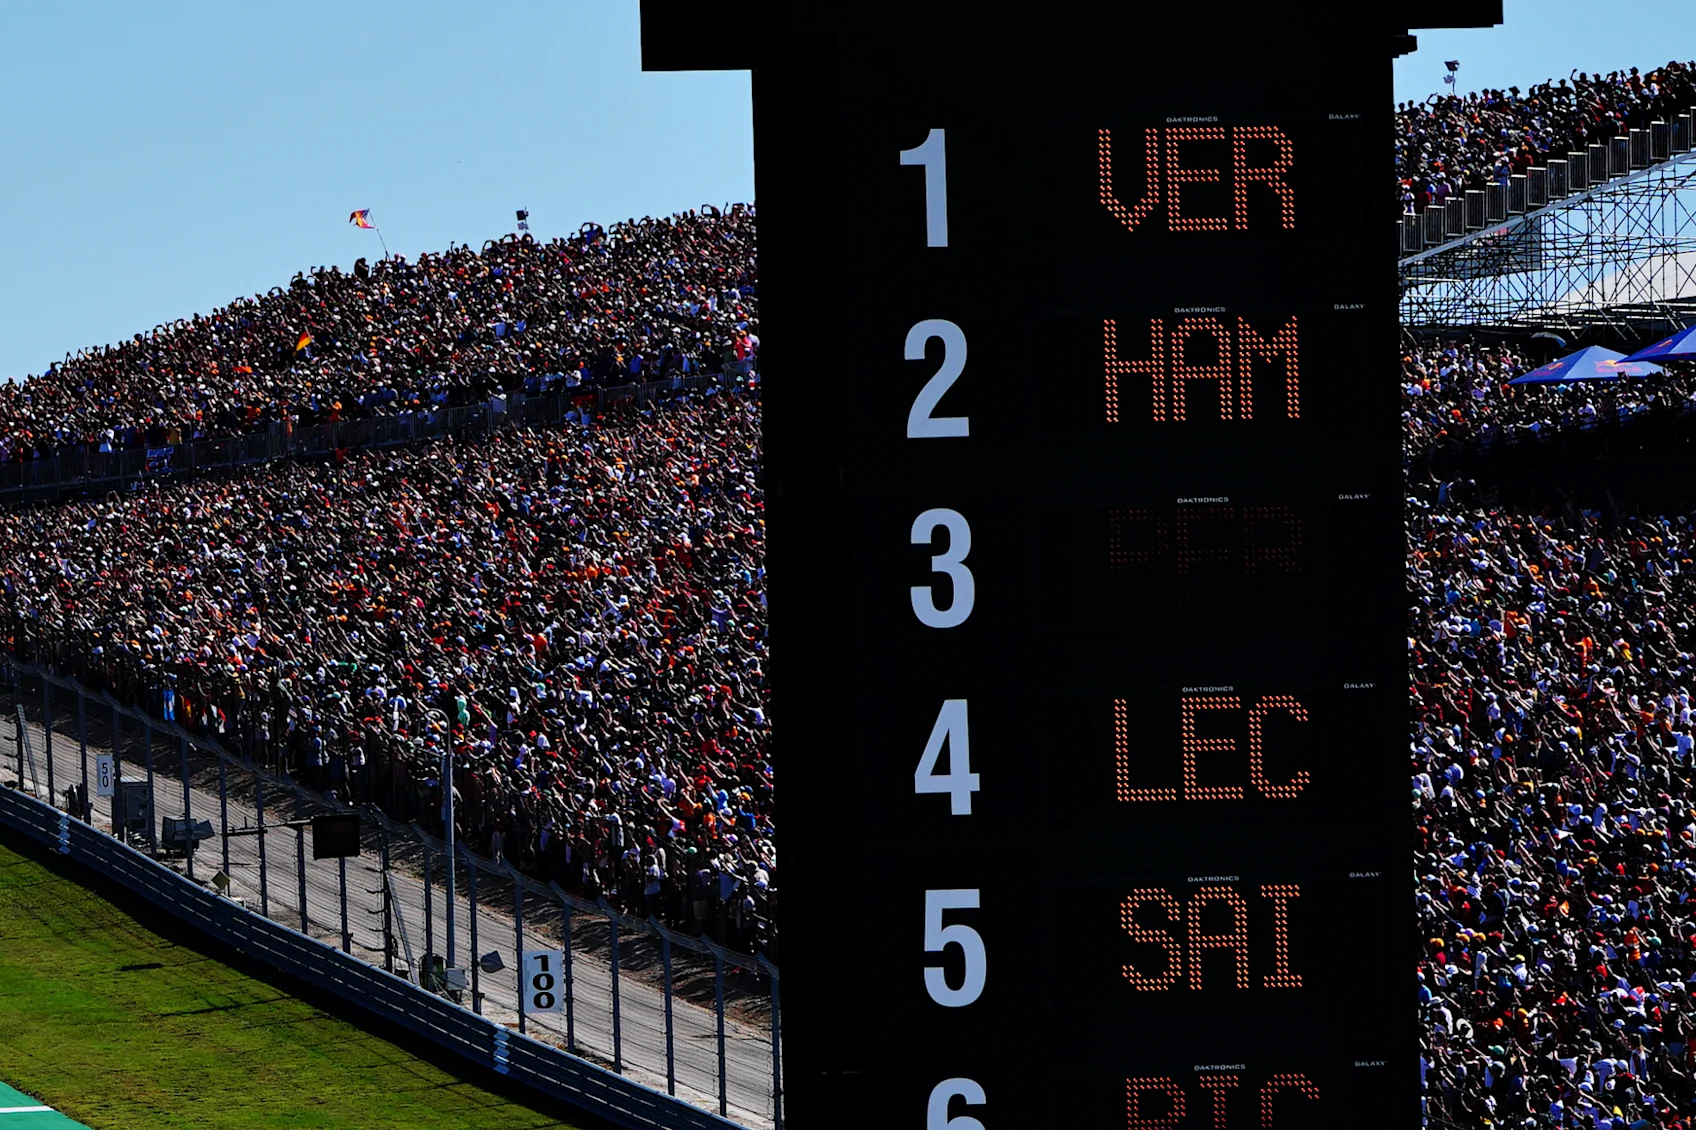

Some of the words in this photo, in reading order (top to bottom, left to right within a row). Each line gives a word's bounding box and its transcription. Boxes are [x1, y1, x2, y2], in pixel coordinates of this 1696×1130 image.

[900, 129, 947, 247] 1
[1099, 126, 1294, 232] VER
[1173, 306, 1226, 314] DAKTRONICS
[905, 319, 969, 438] 2
[1104, 316, 1299, 422] HAM
[1176, 496, 1230, 504] DAKTRONICS
[911, 508, 975, 628] 3
[1181, 685, 1234, 693] DAKTRONICS
[101, 762, 109, 788] 50
[915, 699, 980, 815] 4
[1115, 696, 1309, 801] LEC
[1187, 875, 1240, 883] DAKTRONICS
[924, 889, 986, 1007] 5
[1120, 885, 1302, 990] SAI
[532, 954, 555, 1009] 100
[1193, 1063, 1246, 1072] DAKTRONICS
